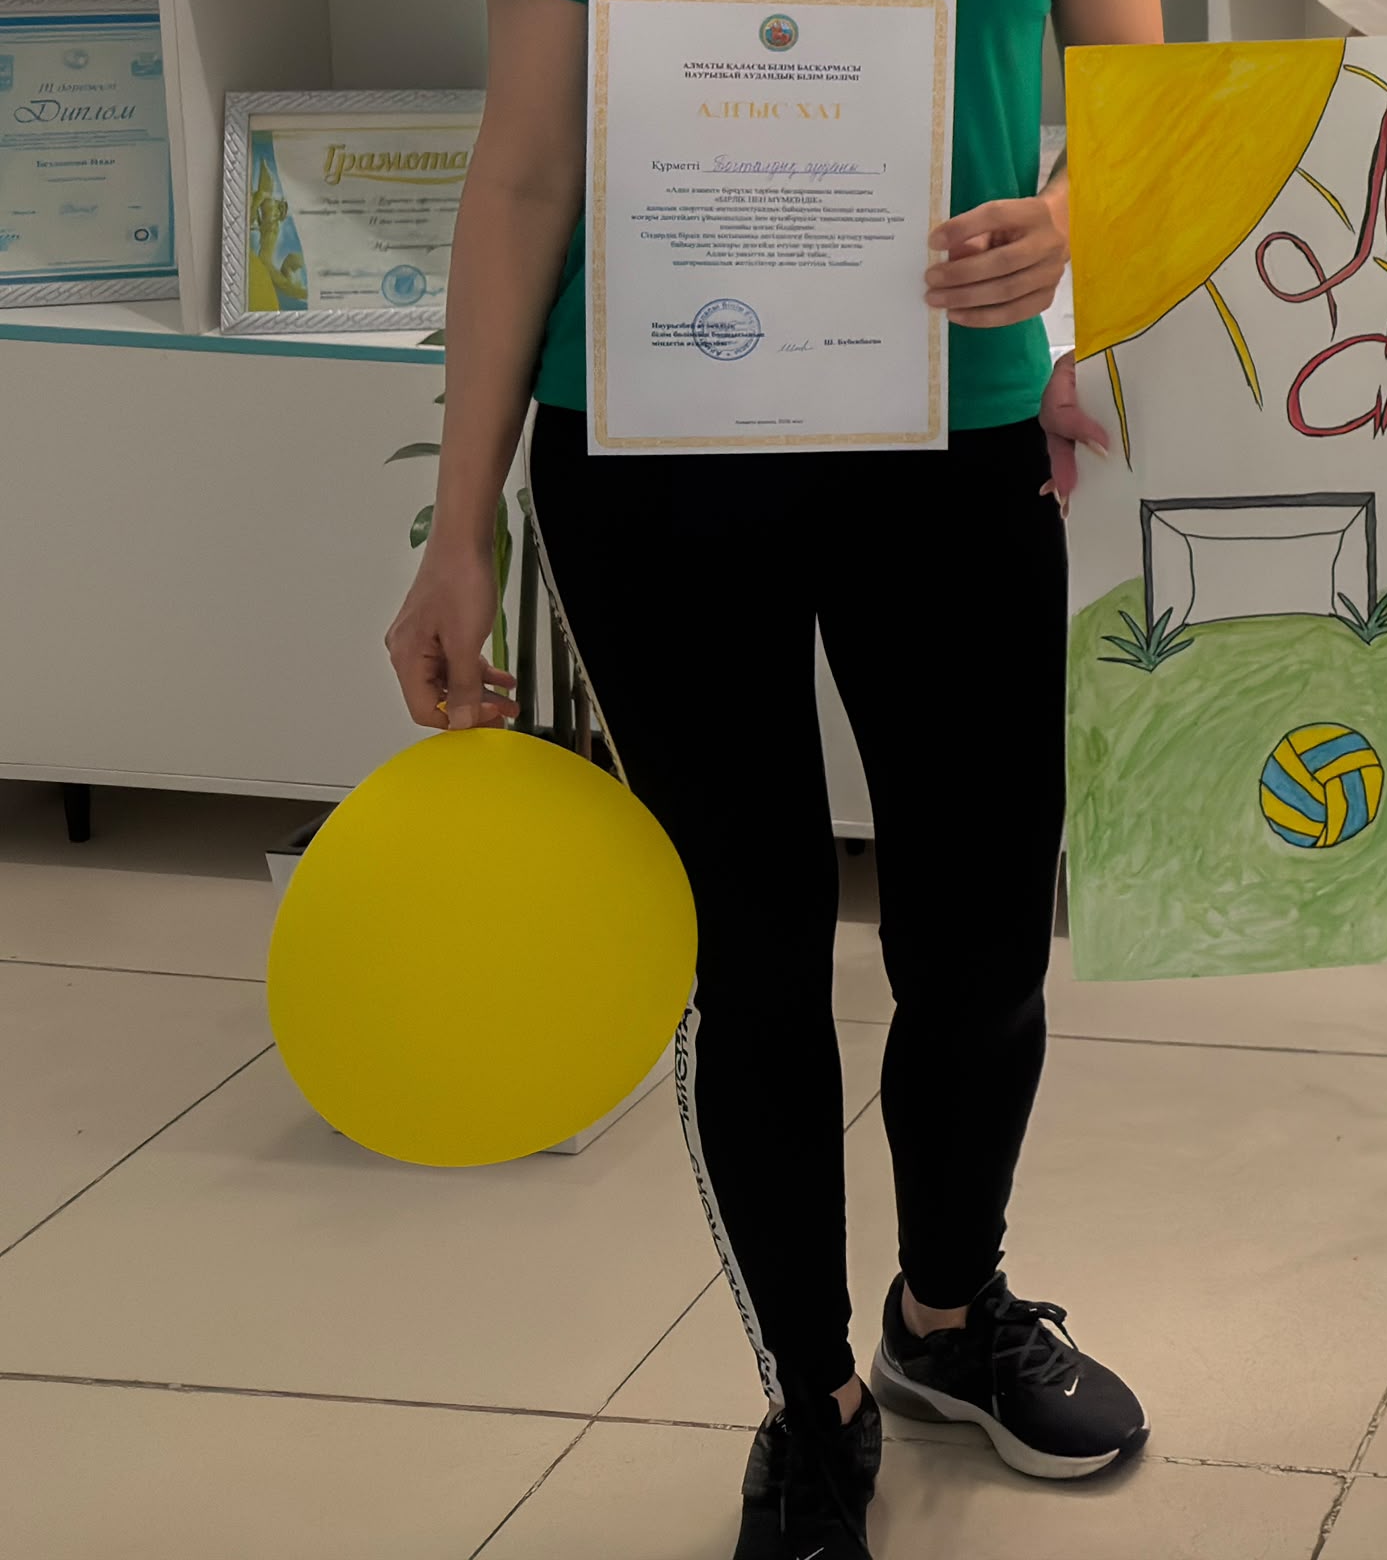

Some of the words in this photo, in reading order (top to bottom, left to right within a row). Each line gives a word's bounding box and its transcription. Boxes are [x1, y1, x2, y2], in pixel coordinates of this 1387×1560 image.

[683, 62, 724, 71] АЛМАТЫ
[726, 63, 766, 72] ҚАЛАСЫ
[767, 63, 795, 72] БІЛІМ
[797, 64, 862, 73] БАСҚАРМАСЫ
[684, 71, 741, 80] НАУРЫЗБАЙ
[743, 72, 795, 81] АУДАНДЫҚ
[796, 73, 824, 81] БІЛІМ
[13, 99, 136, 123] Диплом
[796, 102, 845, 121] ХАТ
[323, 144, 468, 186] Грамота
[651, 160, 700, 173] Құрметті
